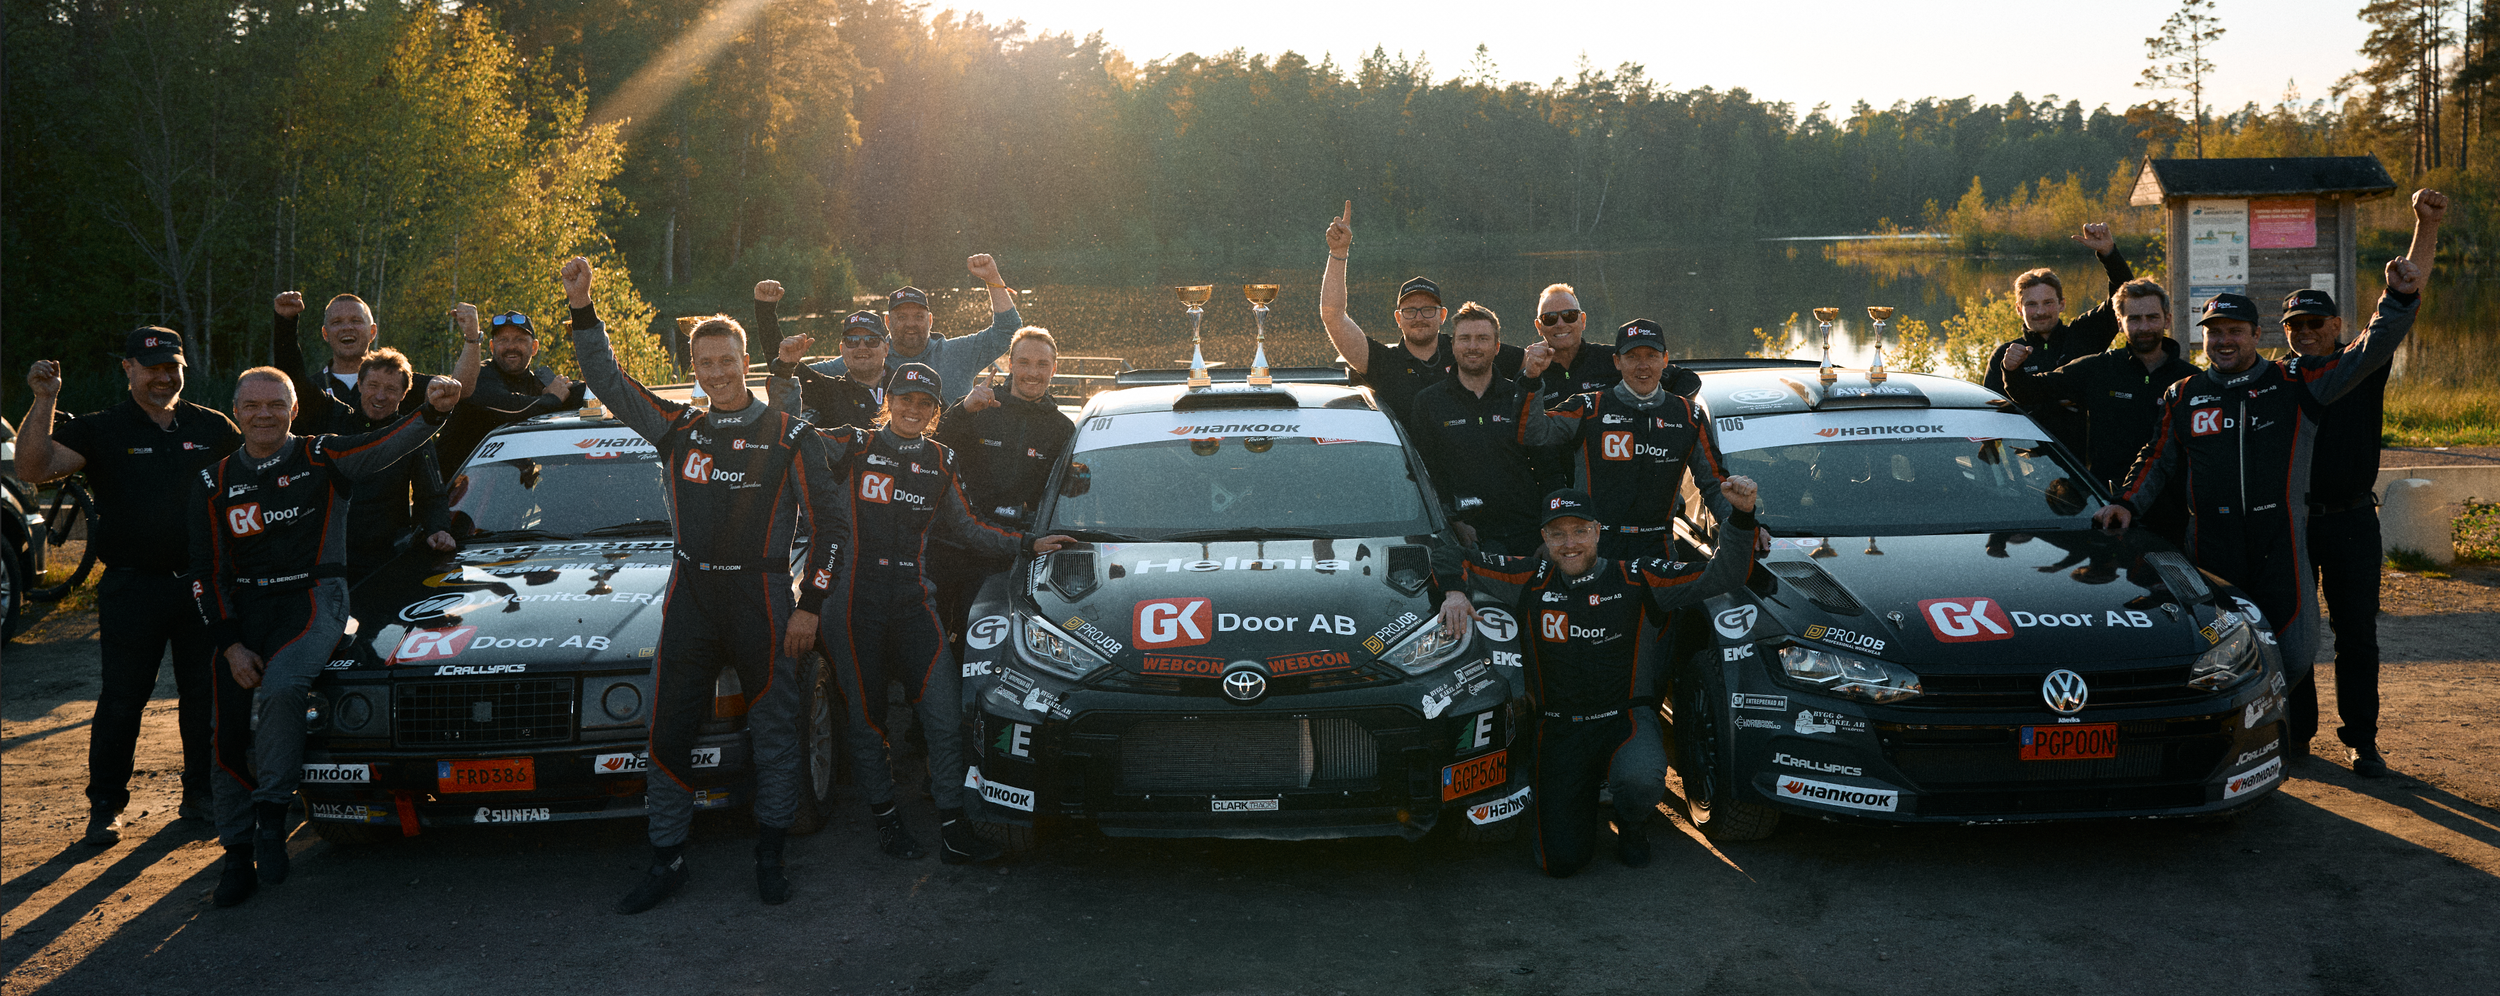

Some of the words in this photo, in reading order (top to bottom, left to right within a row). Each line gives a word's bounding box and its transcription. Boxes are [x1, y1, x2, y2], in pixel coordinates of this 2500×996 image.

[2208, 300, 2219, 311] GK
[2289, 297, 2299, 306] GK
[1627, 326, 1639, 338] GK
[906, 371, 918, 380] GK
[2227, 374, 2251, 386] HRX
[717, 416, 743, 425] HRX
[1091, 416, 1114, 432] 101
[1718, 416, 1745, 432] 106
[2193, 409, 2221, 435] GK
[788, 421, 807, 440] HRX
[477, 441, 505, 459] 122
[733, 439, 746, 450] GK
[745, 442, 760, 450] Door
[1604, 434, 1631, 458] GK
[1634, 443, 1668, 457] Door
[257, 455, 282, 471] HRX
[683, 452, 712, 482] GK
[711, 467, 746, 482] Door
[861, 474, 892, 502] GK
[893, 488, 925, 505] Door
[1550, 498, 1562, 510] GK
[228, 505, 262, 535] GK
[262, 506, 300, 525] Door
[814, 569, 832, 589] GK
[831, 543, 839, 555] AB
[1134, 556, 1351, 575] Helmia
[1572, 573, 1595, 585] HRX
[1589, 594, 1600, 606] GK
[1139, 600, 1205, 643] GK
[1217, 613, 1299, 632] Door
[1308, 613, 1358, 636] AB
[1374, 611, 1419, 642] PROJOB
[1542, 612, 1567, 641] GK
[1569, 624, 1607, 639] Door
[1928, 600, 2008, 637] GK
[2009, 611, 2093, 629] Door
[2106, 610, 2154, 629] AB
[394, 627, 470, 660] GK
[469, 636, 554, 650] Door
[558, 634, 612, 651] AB
[1078, 622, 1123, 655] PROJOB
[1825, 626, 1886, 651] PROJOB
[1492, 650, 1523, 668] EMC
[1723, 643, 1755, 662] EMC
[962, 660, 993, 678] EMC
[1143, 656, 1226, 675] WEBCON
[1267, 650, 1351, 674] WEBCON
[1813, 710, 1835, 719] BYGG
[1823, 717, 1851, 727] KAKEL
[456, 767, 527, 785] FRD386
[1452, 754, 1507, 795] GGP56M
[312, 803, 368, 816] MIKAB
[1212, 801, 1249, 811] CLARK
[494, 807, 551, 824] SUNFAB
